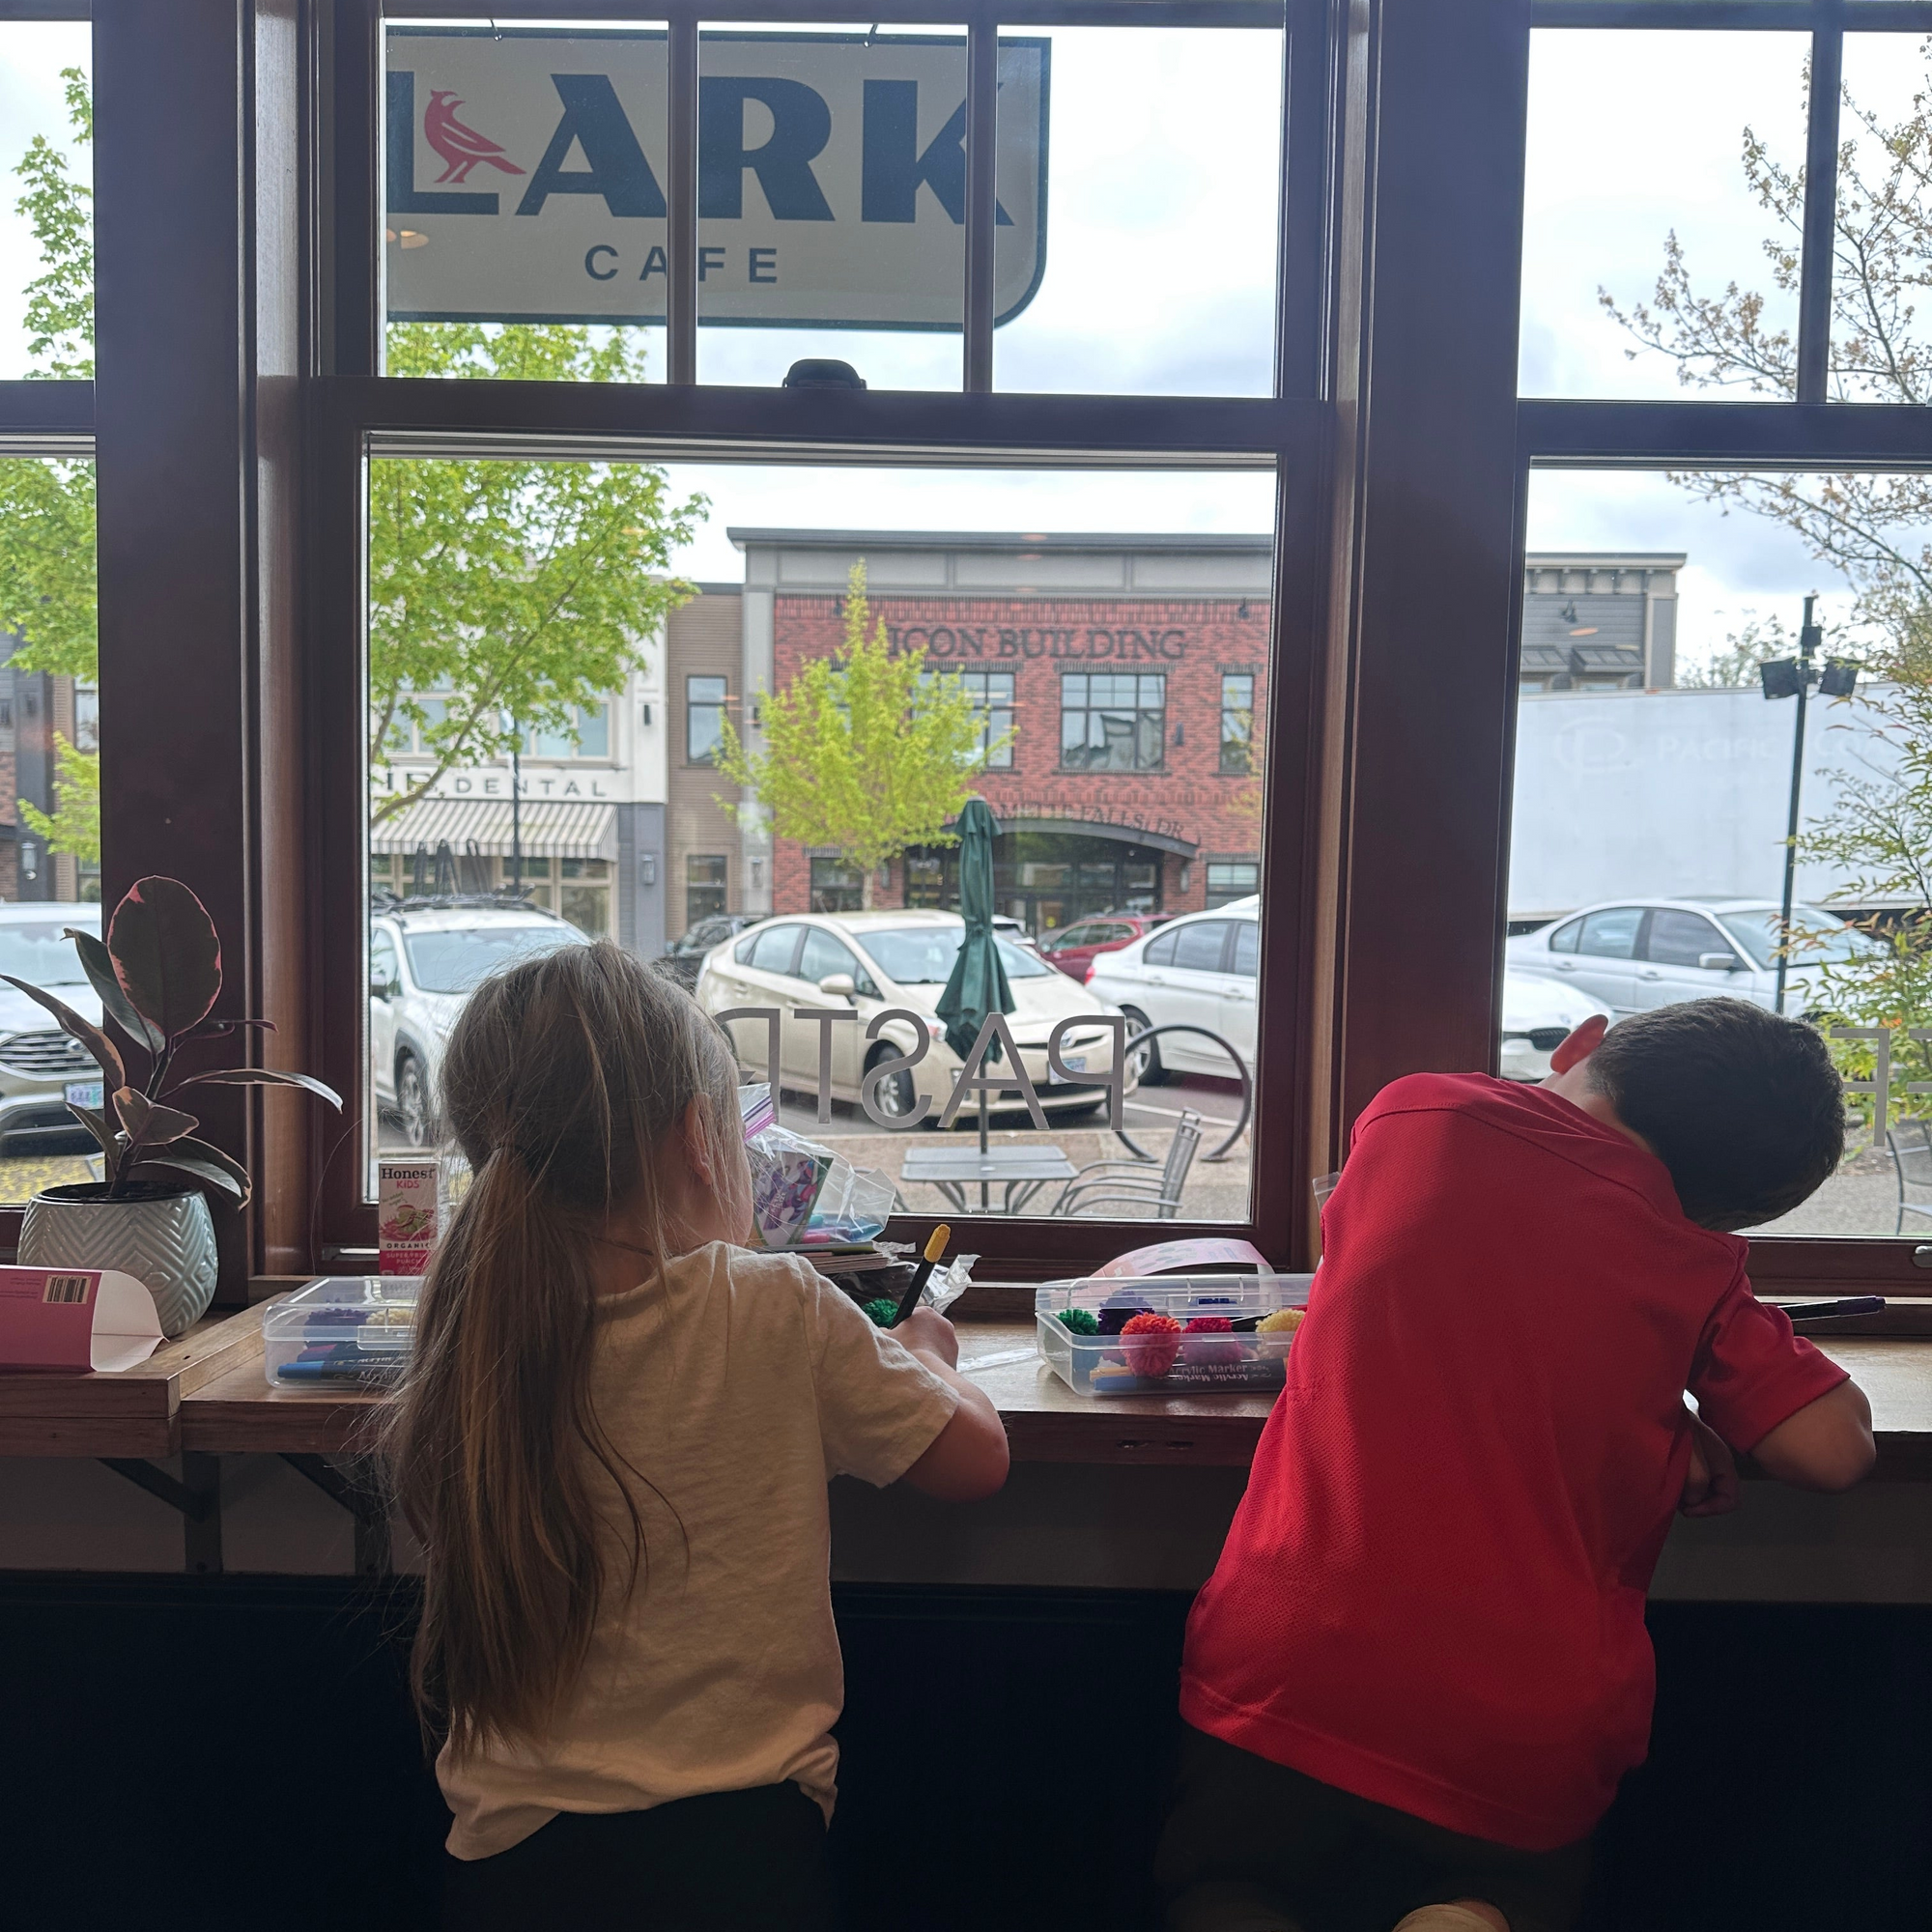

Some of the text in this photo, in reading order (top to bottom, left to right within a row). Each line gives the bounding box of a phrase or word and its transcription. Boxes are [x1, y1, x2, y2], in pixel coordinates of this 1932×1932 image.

[386, 71, 1014, 227] LARK
[583, 243, 779, 284] CAFE
[888, 627, 1189, 660] ICON BUILDING
[1658, 736, 1779, 762] PACIFIC
[454, 777, 607, 797] DENTAL
[1081, 806, 1146, 831] FALLS
[1157, 817, 1184, 840] DR
[382, 1167, 437, 1179] Honest
[1168, 1364, 1248, 1375] Acrylic Marker
